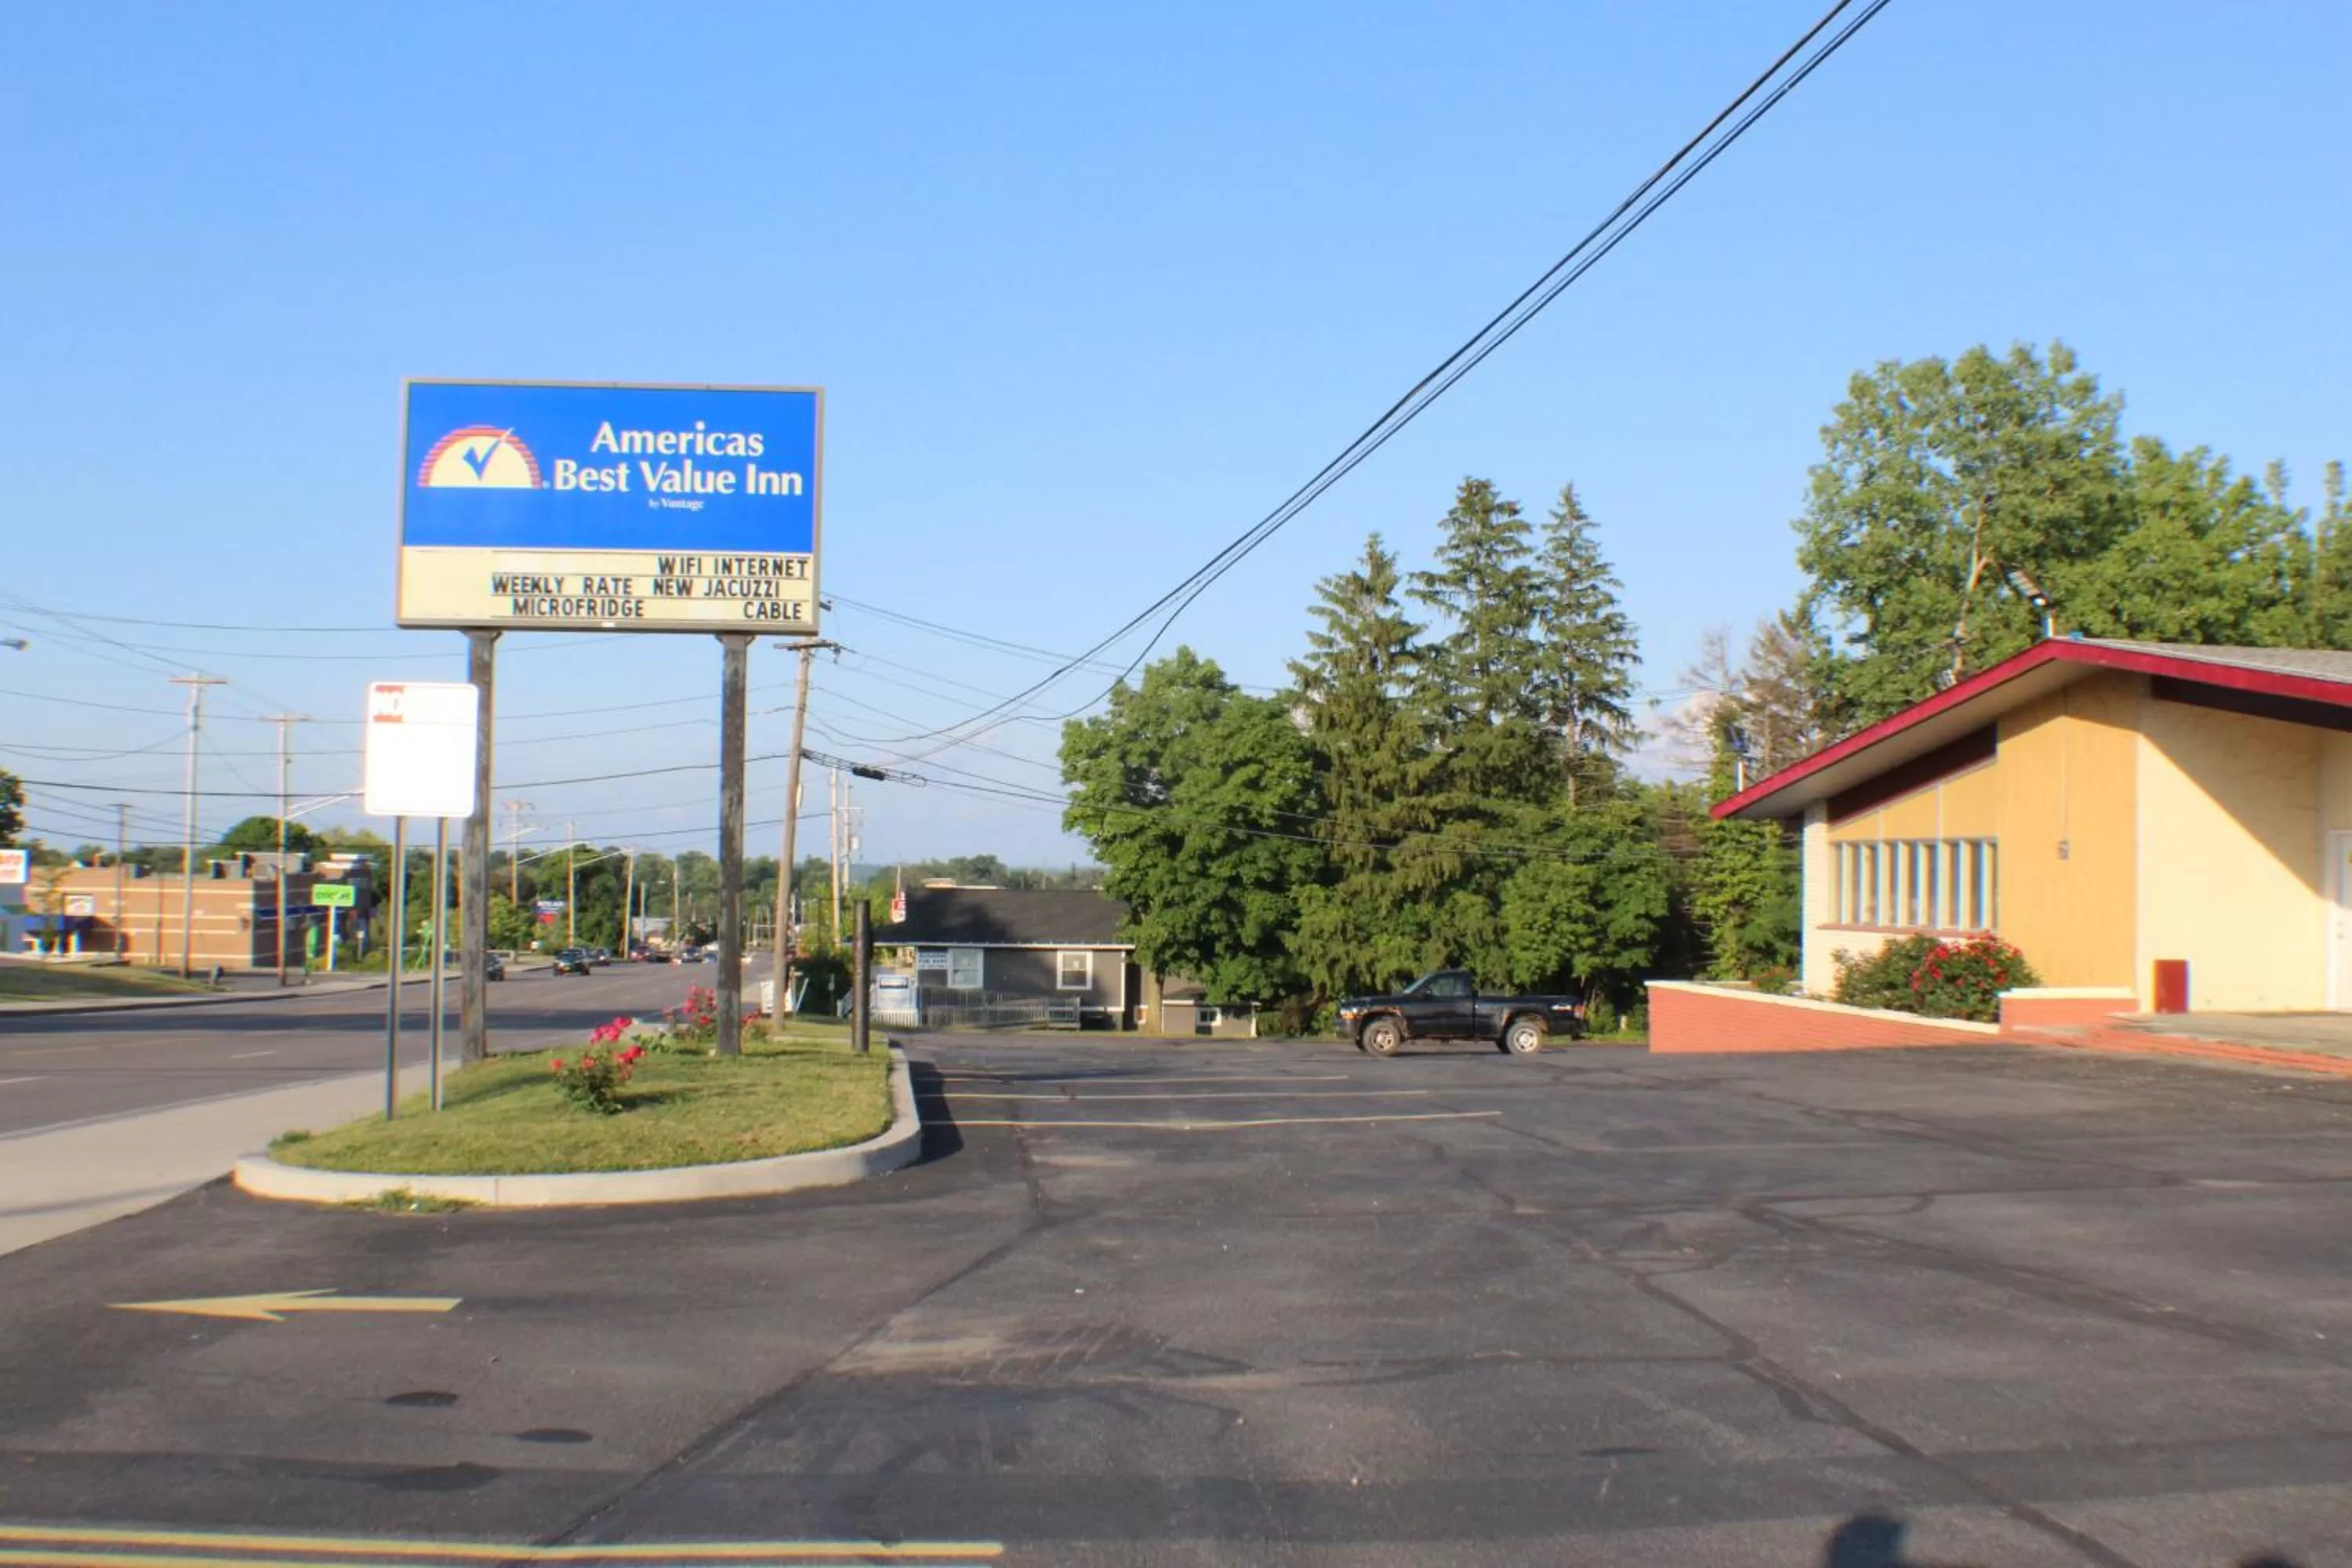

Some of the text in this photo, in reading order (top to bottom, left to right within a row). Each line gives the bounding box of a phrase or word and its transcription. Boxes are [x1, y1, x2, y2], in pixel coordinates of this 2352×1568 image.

[590, 421, 765, 457] Americas
[554, 459, 803, 495] Best Value Inn
[658, 556, 809, 578] WIFI INTERNET
[492, 575, 780, 598] WEEKLY RATE NEW JACUZZI
[512, 597, 802, 620] MICROFRIDGE CABLE
